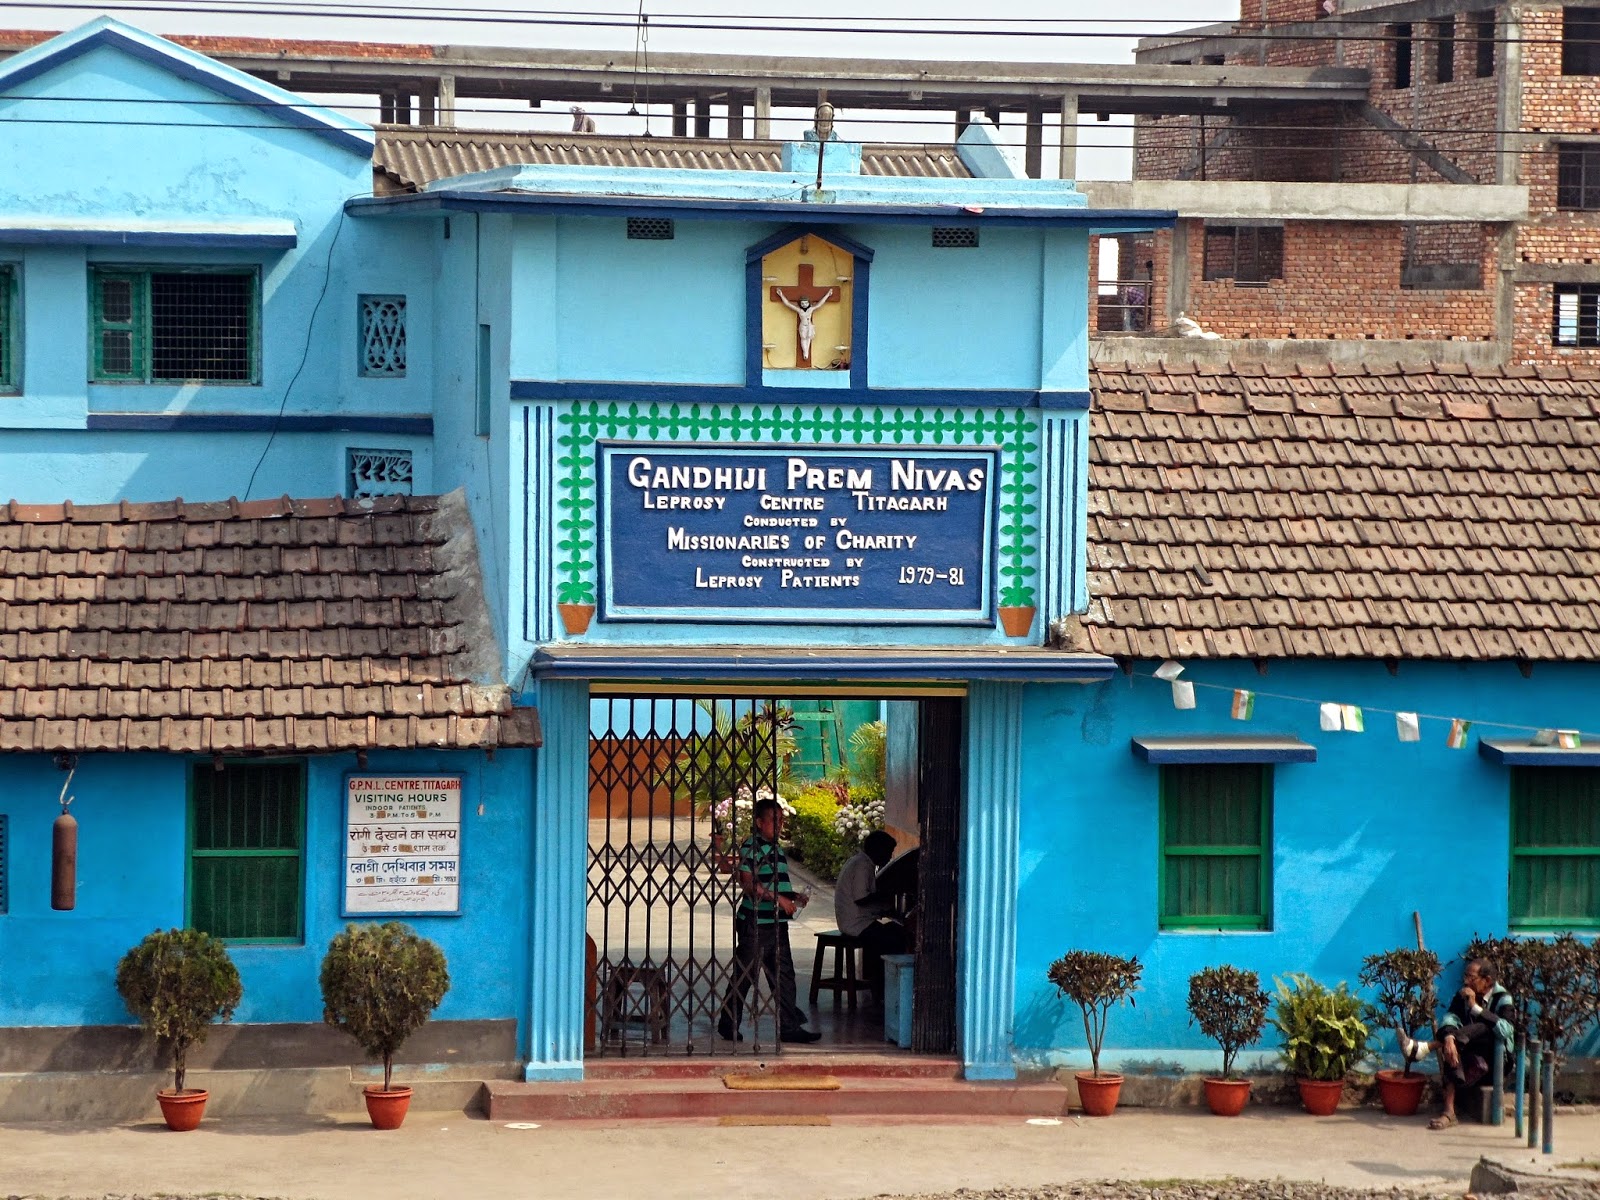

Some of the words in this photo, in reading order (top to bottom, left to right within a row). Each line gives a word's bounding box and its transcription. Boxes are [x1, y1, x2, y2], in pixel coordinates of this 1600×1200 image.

[628, 457, 767, 491] GANDHIJI
[787, 458, 872, 490] PREM
[890, 459, 984, 491] NIVAS
[644, 491, 726, 510] LEPROSY
[760, 494, 825, 511] CENTRE
[852, 491, 948, 511] TITAGARH
[744, 515, 818, 527] CONDUCTED
[830, 518, 847, 527] BY
[667, 527, 790, 550] MISSIONARIES
[804, 536, 826, 550] OF
[836, 529, 917, 550] CHARITY
[742, 555, 830, 568] CONSTRUCTED
[846, 558, 864, 568] BY
[695, 567, 763, 588] LEPROSY
[781, 569, 860, 588] PATIENTS
[355, 794, 404, 803] VISITING
[408, 793, 447, 803] HOURS
[350, 827, 371, 841] रोगी
[375, 827, 407, 842] देखने
[410, 829, 424, 840] का
[427, 829, 456, 840] समय
[350, 859, 379, 873] রোগী
[382, 858, 426, 874] দেখিবার
[428, 860, 456, 872] সময়
